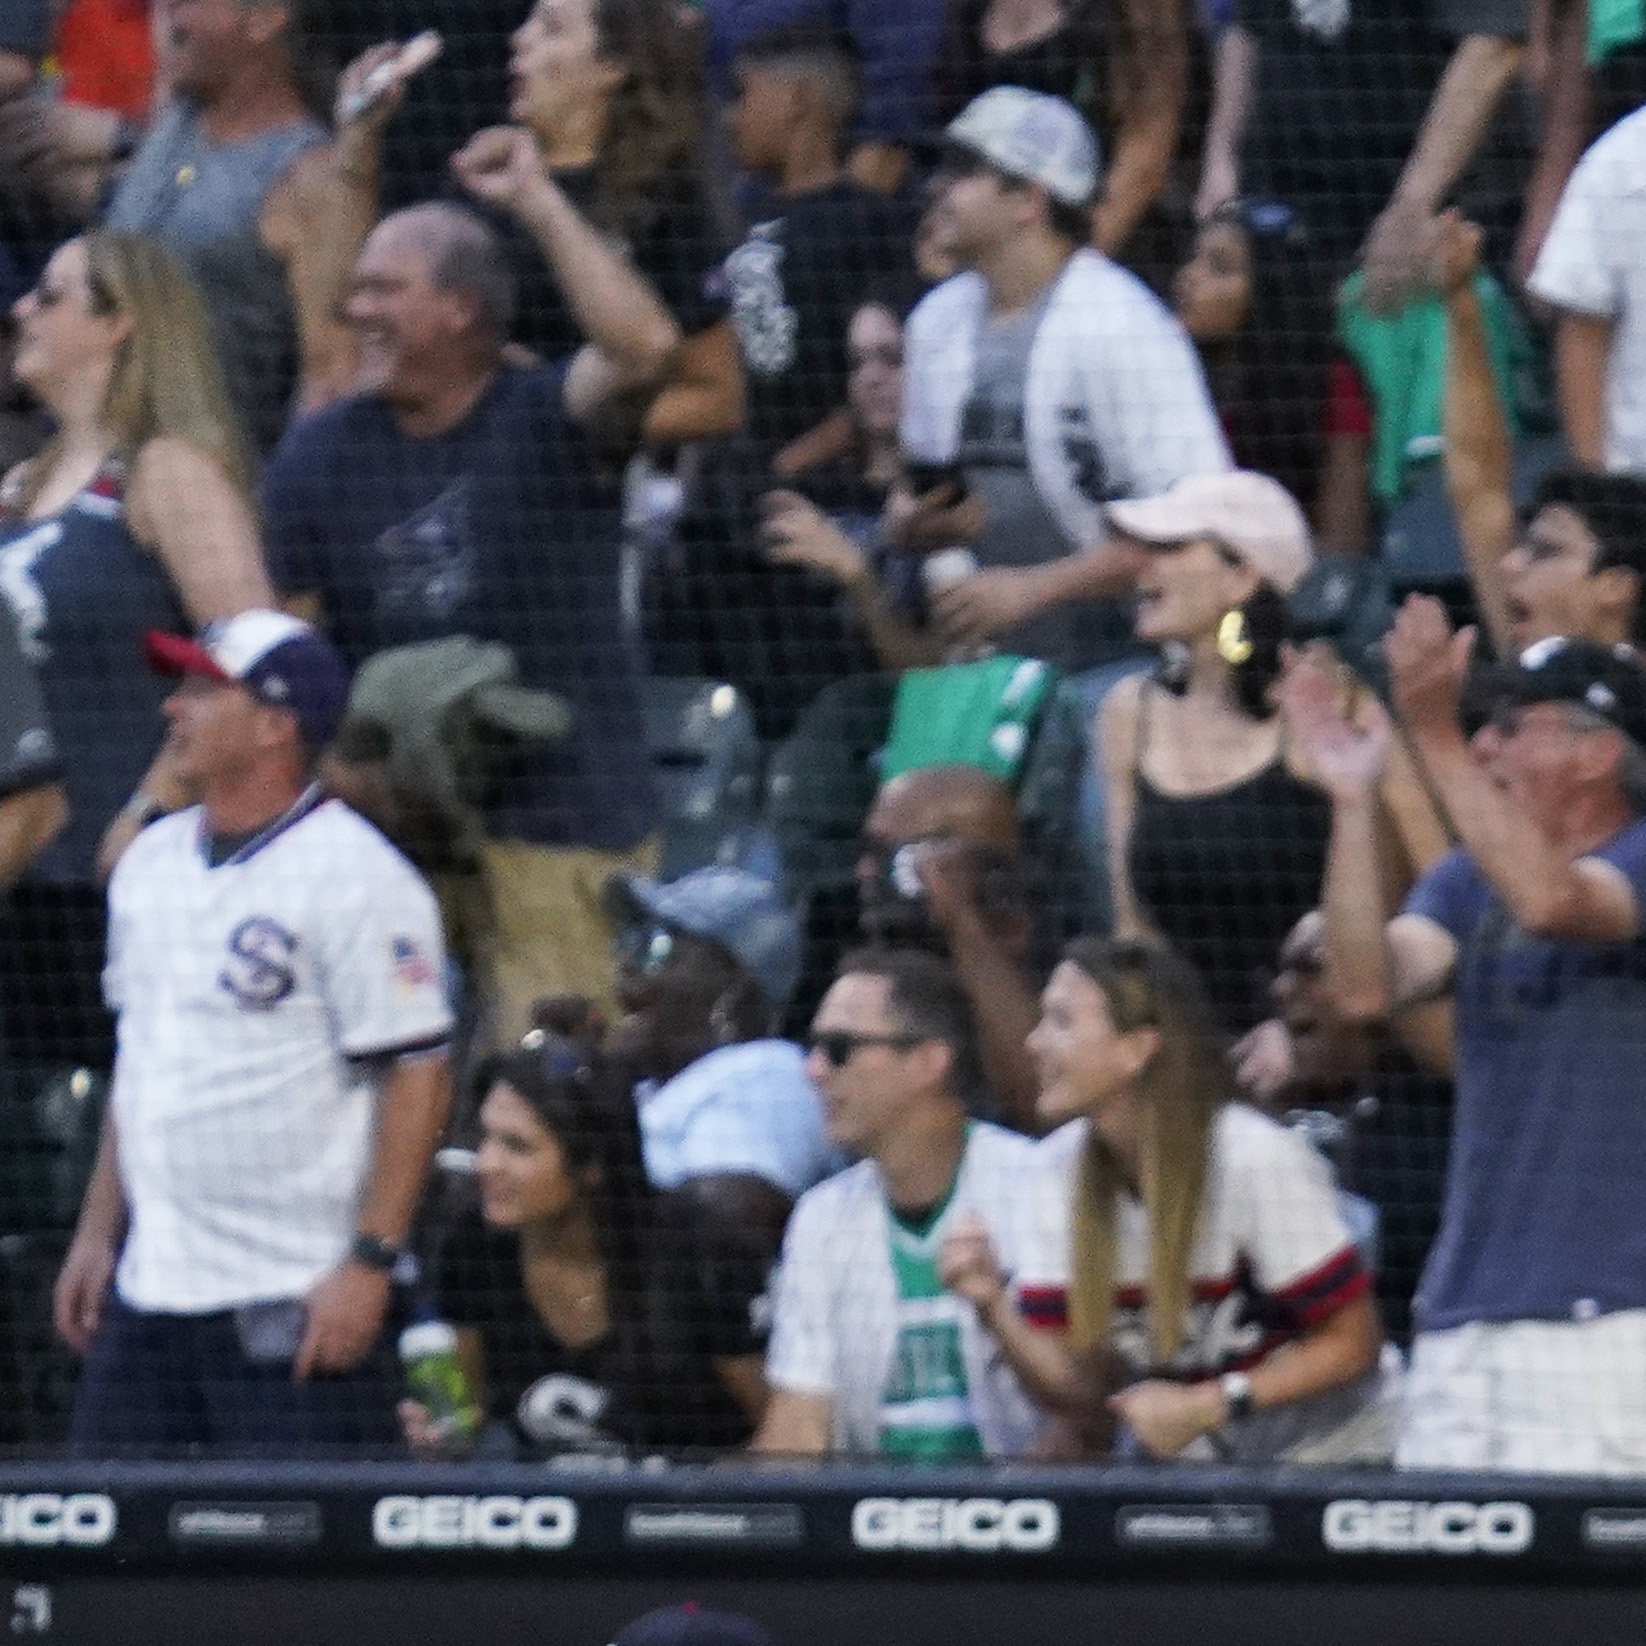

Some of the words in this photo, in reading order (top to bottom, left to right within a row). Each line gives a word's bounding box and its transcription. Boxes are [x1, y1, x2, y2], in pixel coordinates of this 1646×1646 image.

[0, 1492, 117, 1545] ICO
[372, 1494, 578, 1549] GEICO
[851, 1496, 1060, 1552] GEICO
[1321, 1498, 1534, 1554] GEICO
